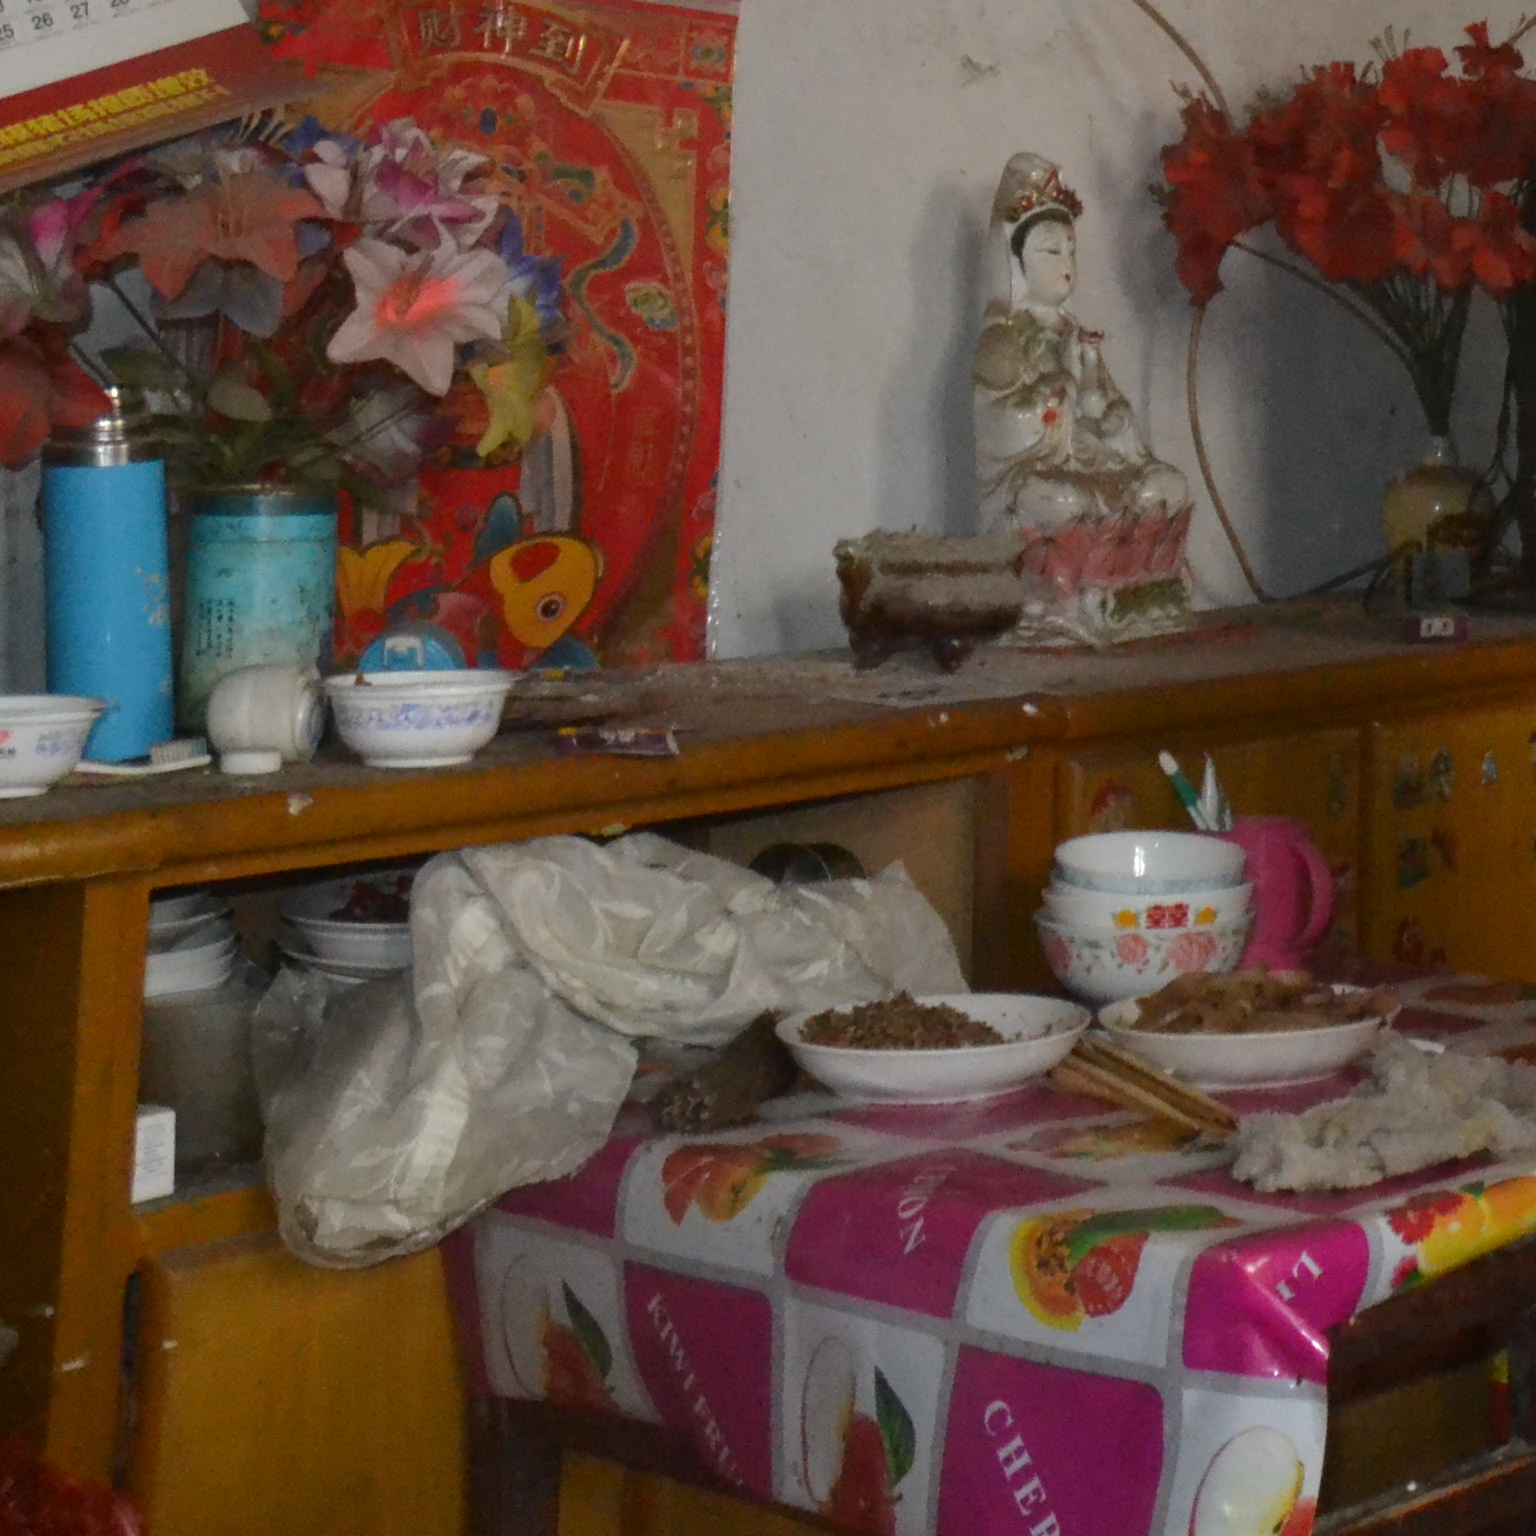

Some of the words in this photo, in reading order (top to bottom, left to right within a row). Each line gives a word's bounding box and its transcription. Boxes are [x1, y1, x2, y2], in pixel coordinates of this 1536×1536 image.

[31, 12, 54, 30] 26
[70, 1, 89, 19] 27
[647, 1293, 694, 1390] KIWI
